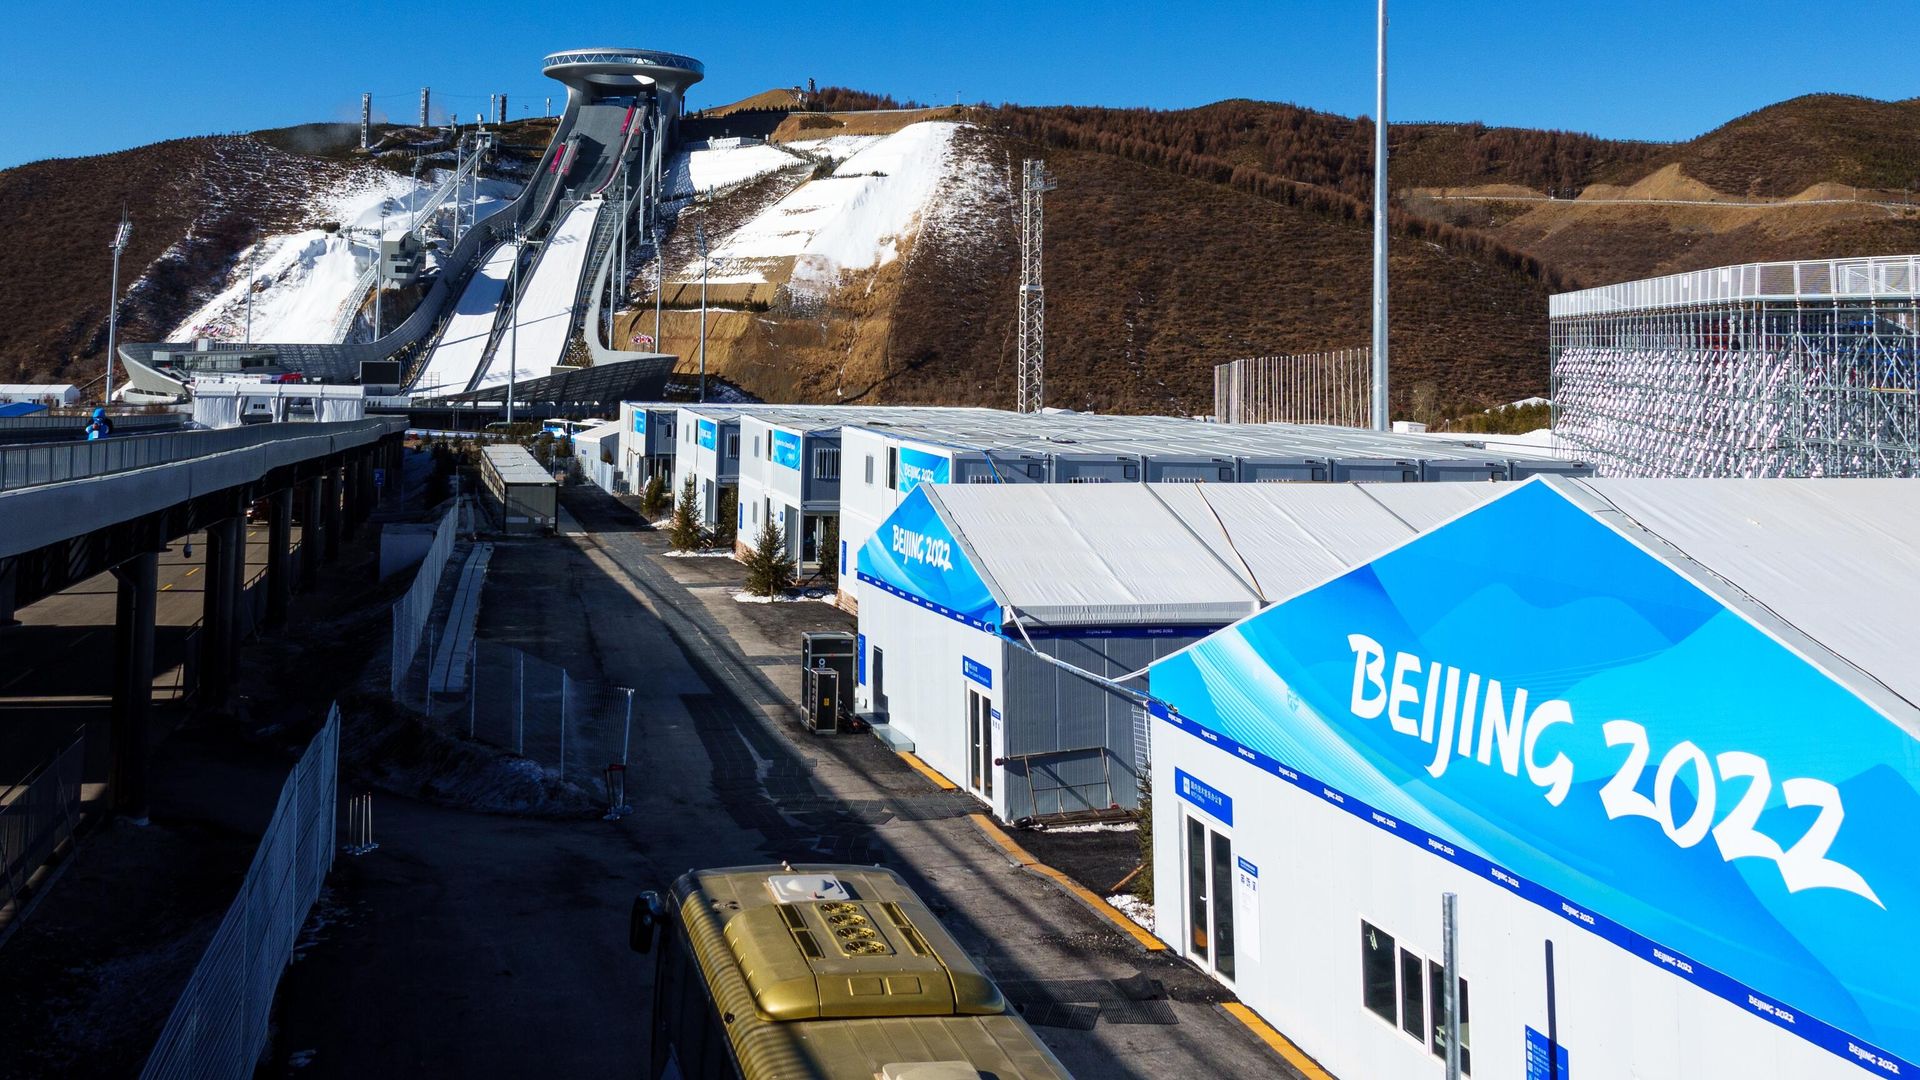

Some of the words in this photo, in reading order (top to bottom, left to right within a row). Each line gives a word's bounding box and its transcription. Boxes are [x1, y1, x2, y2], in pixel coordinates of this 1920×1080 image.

[905, 463, 921, 481] BEIJING
[922, 468, 935, 483] 2022
[893, 524, 923, 564] BEIJING
[926, 536, 953, 572] 2022
[1347, 633, 1574, 807] BEIJING
[1599, 719, 1888, 911] 2022
[1562, 902, 1580, 918] BEIJING
[1580, 912, 1595, 925] 2022
[1654, 949, 1676, 966] BEIJING
[1677, 960, 1694, 974] 2022
[1749, 994, 1774, 1015] BEIJING
[1775, 1007, 1795, 1023] 2022
[1848, 1042, 1876, 1064] BEIJING
[1878, 1057, 1900, 1074] 2022
